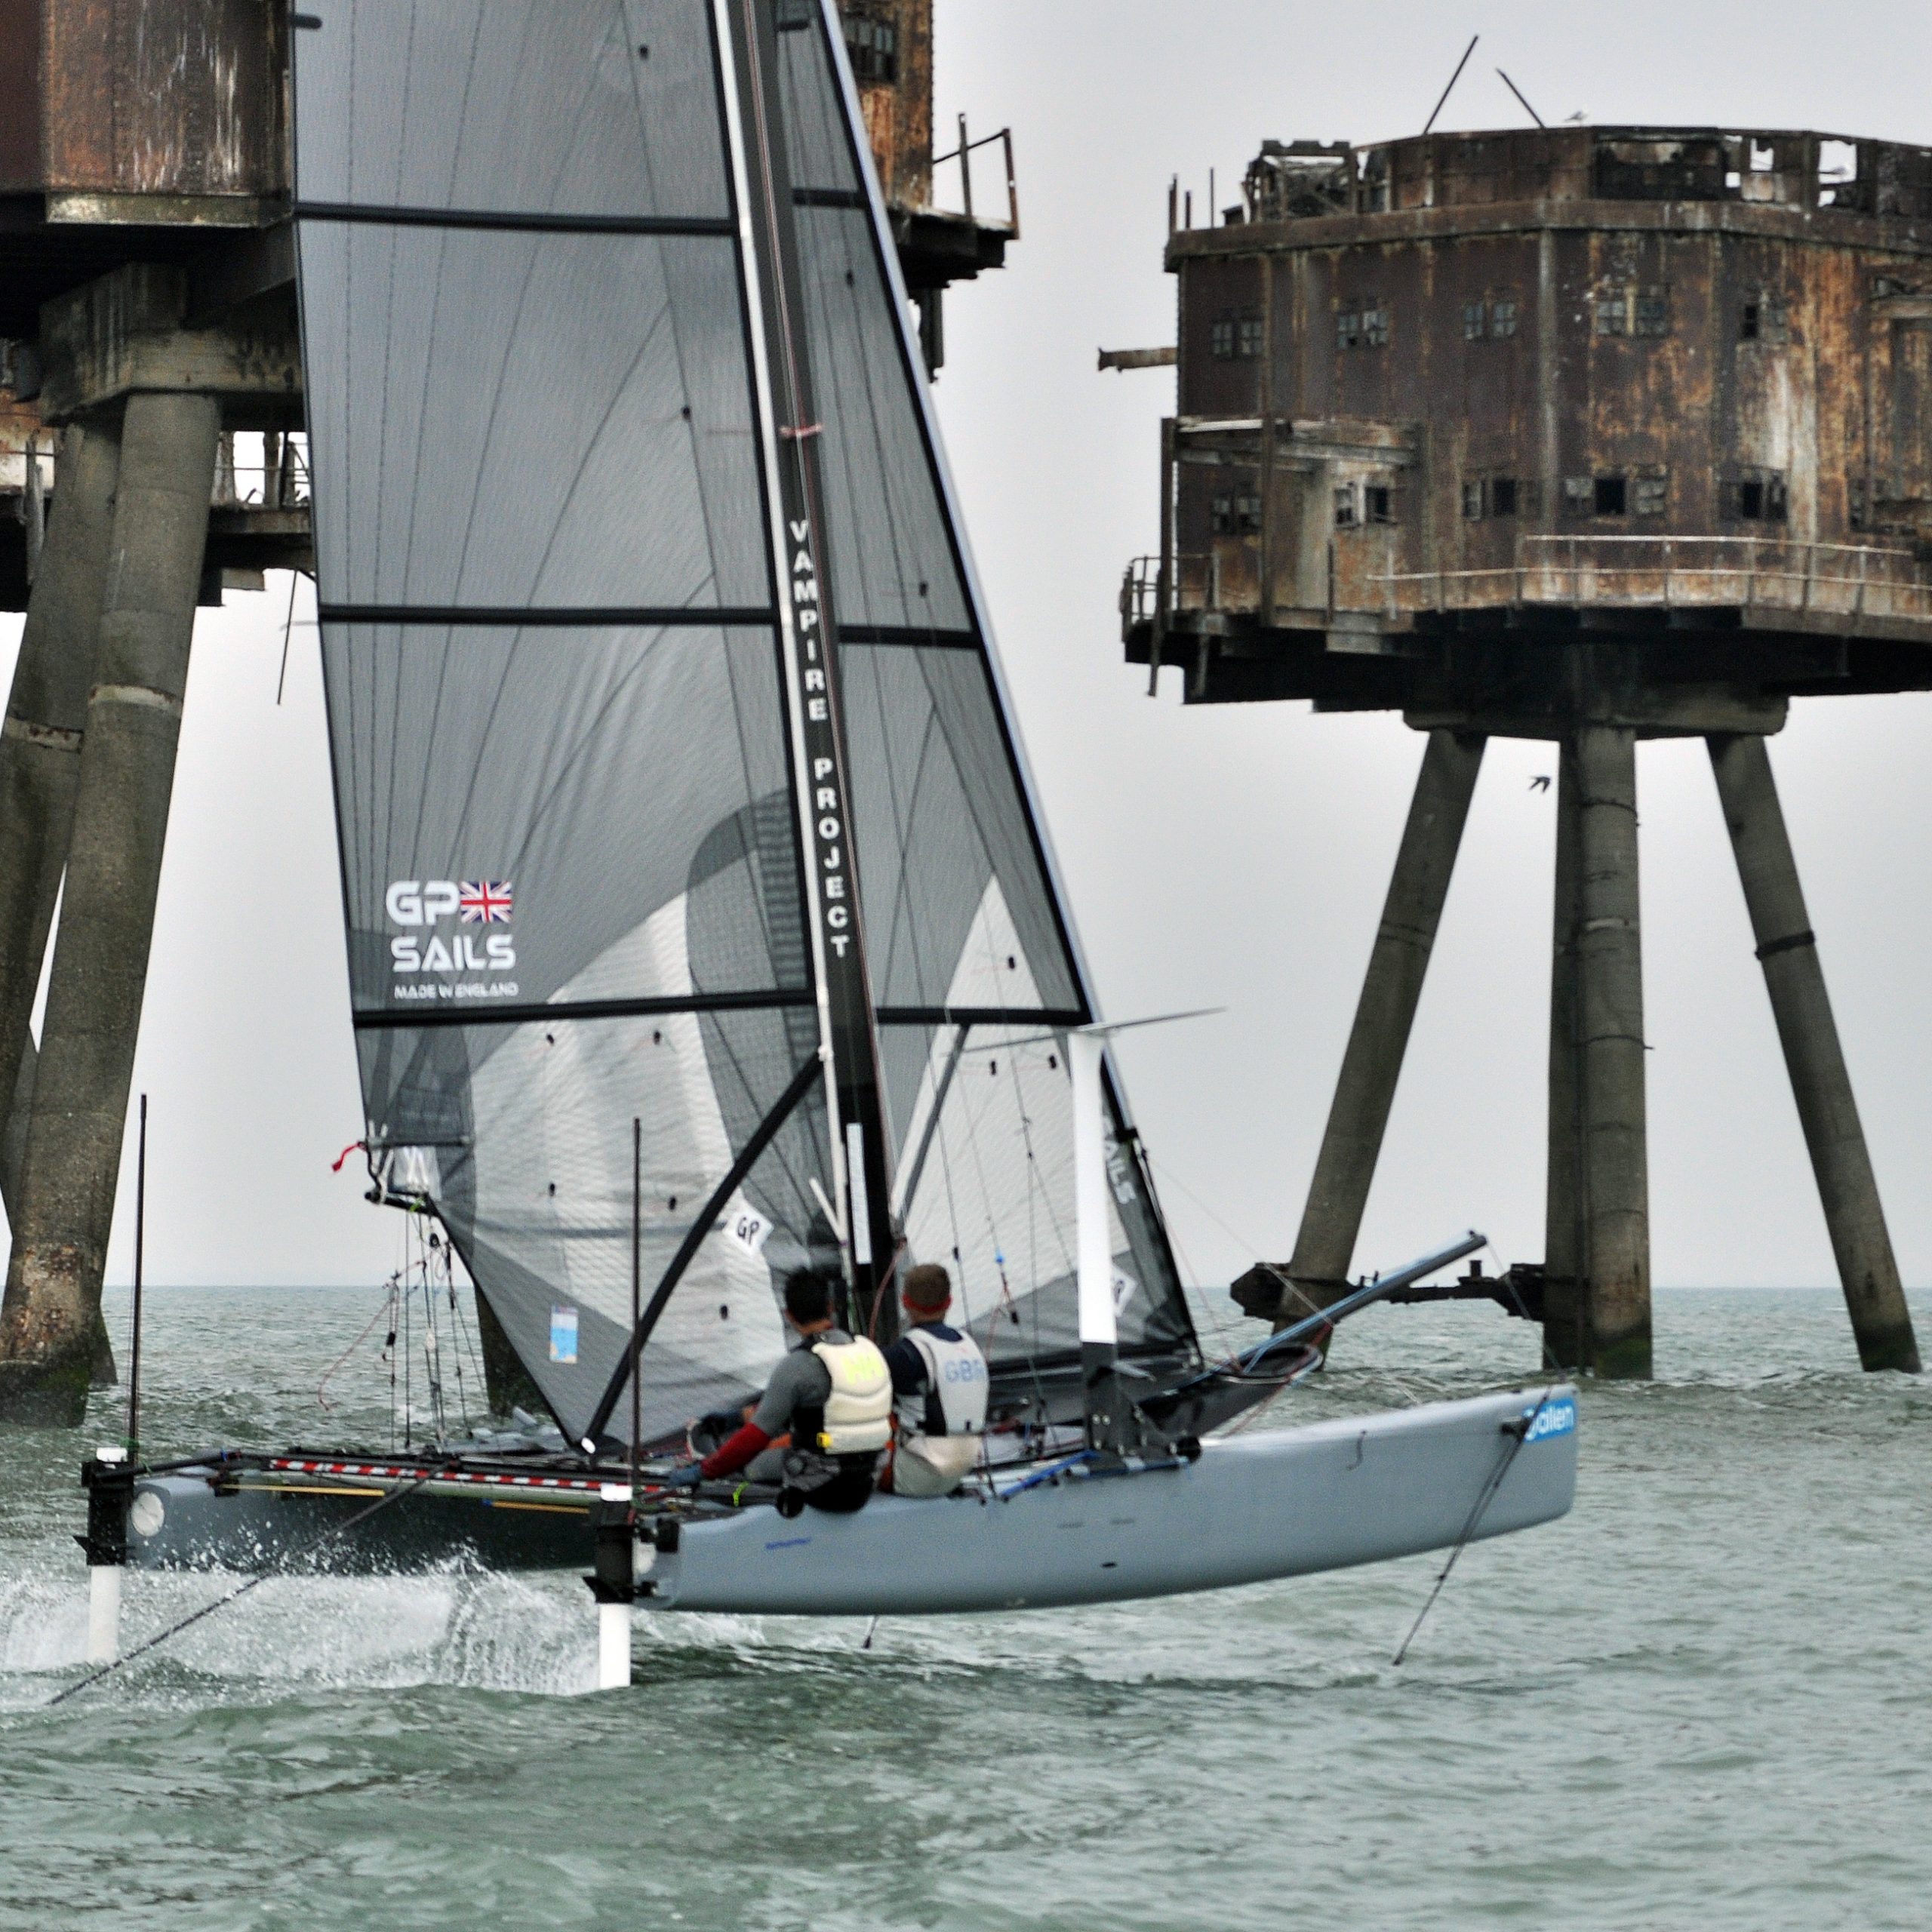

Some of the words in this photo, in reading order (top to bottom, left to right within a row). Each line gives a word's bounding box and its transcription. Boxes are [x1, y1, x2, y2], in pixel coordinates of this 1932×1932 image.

[789, 520, 827, 721] VAMPIRE
[814, 757, 850, 958] PROJECT
[386, 880, 460, 926] GP
[390, 934, 516, 972] SAILS
[394, 983, 436, 999] MADE
[454, 981, 519, 998] ENGLAND
[737, 1216, 760, 1246] GP
